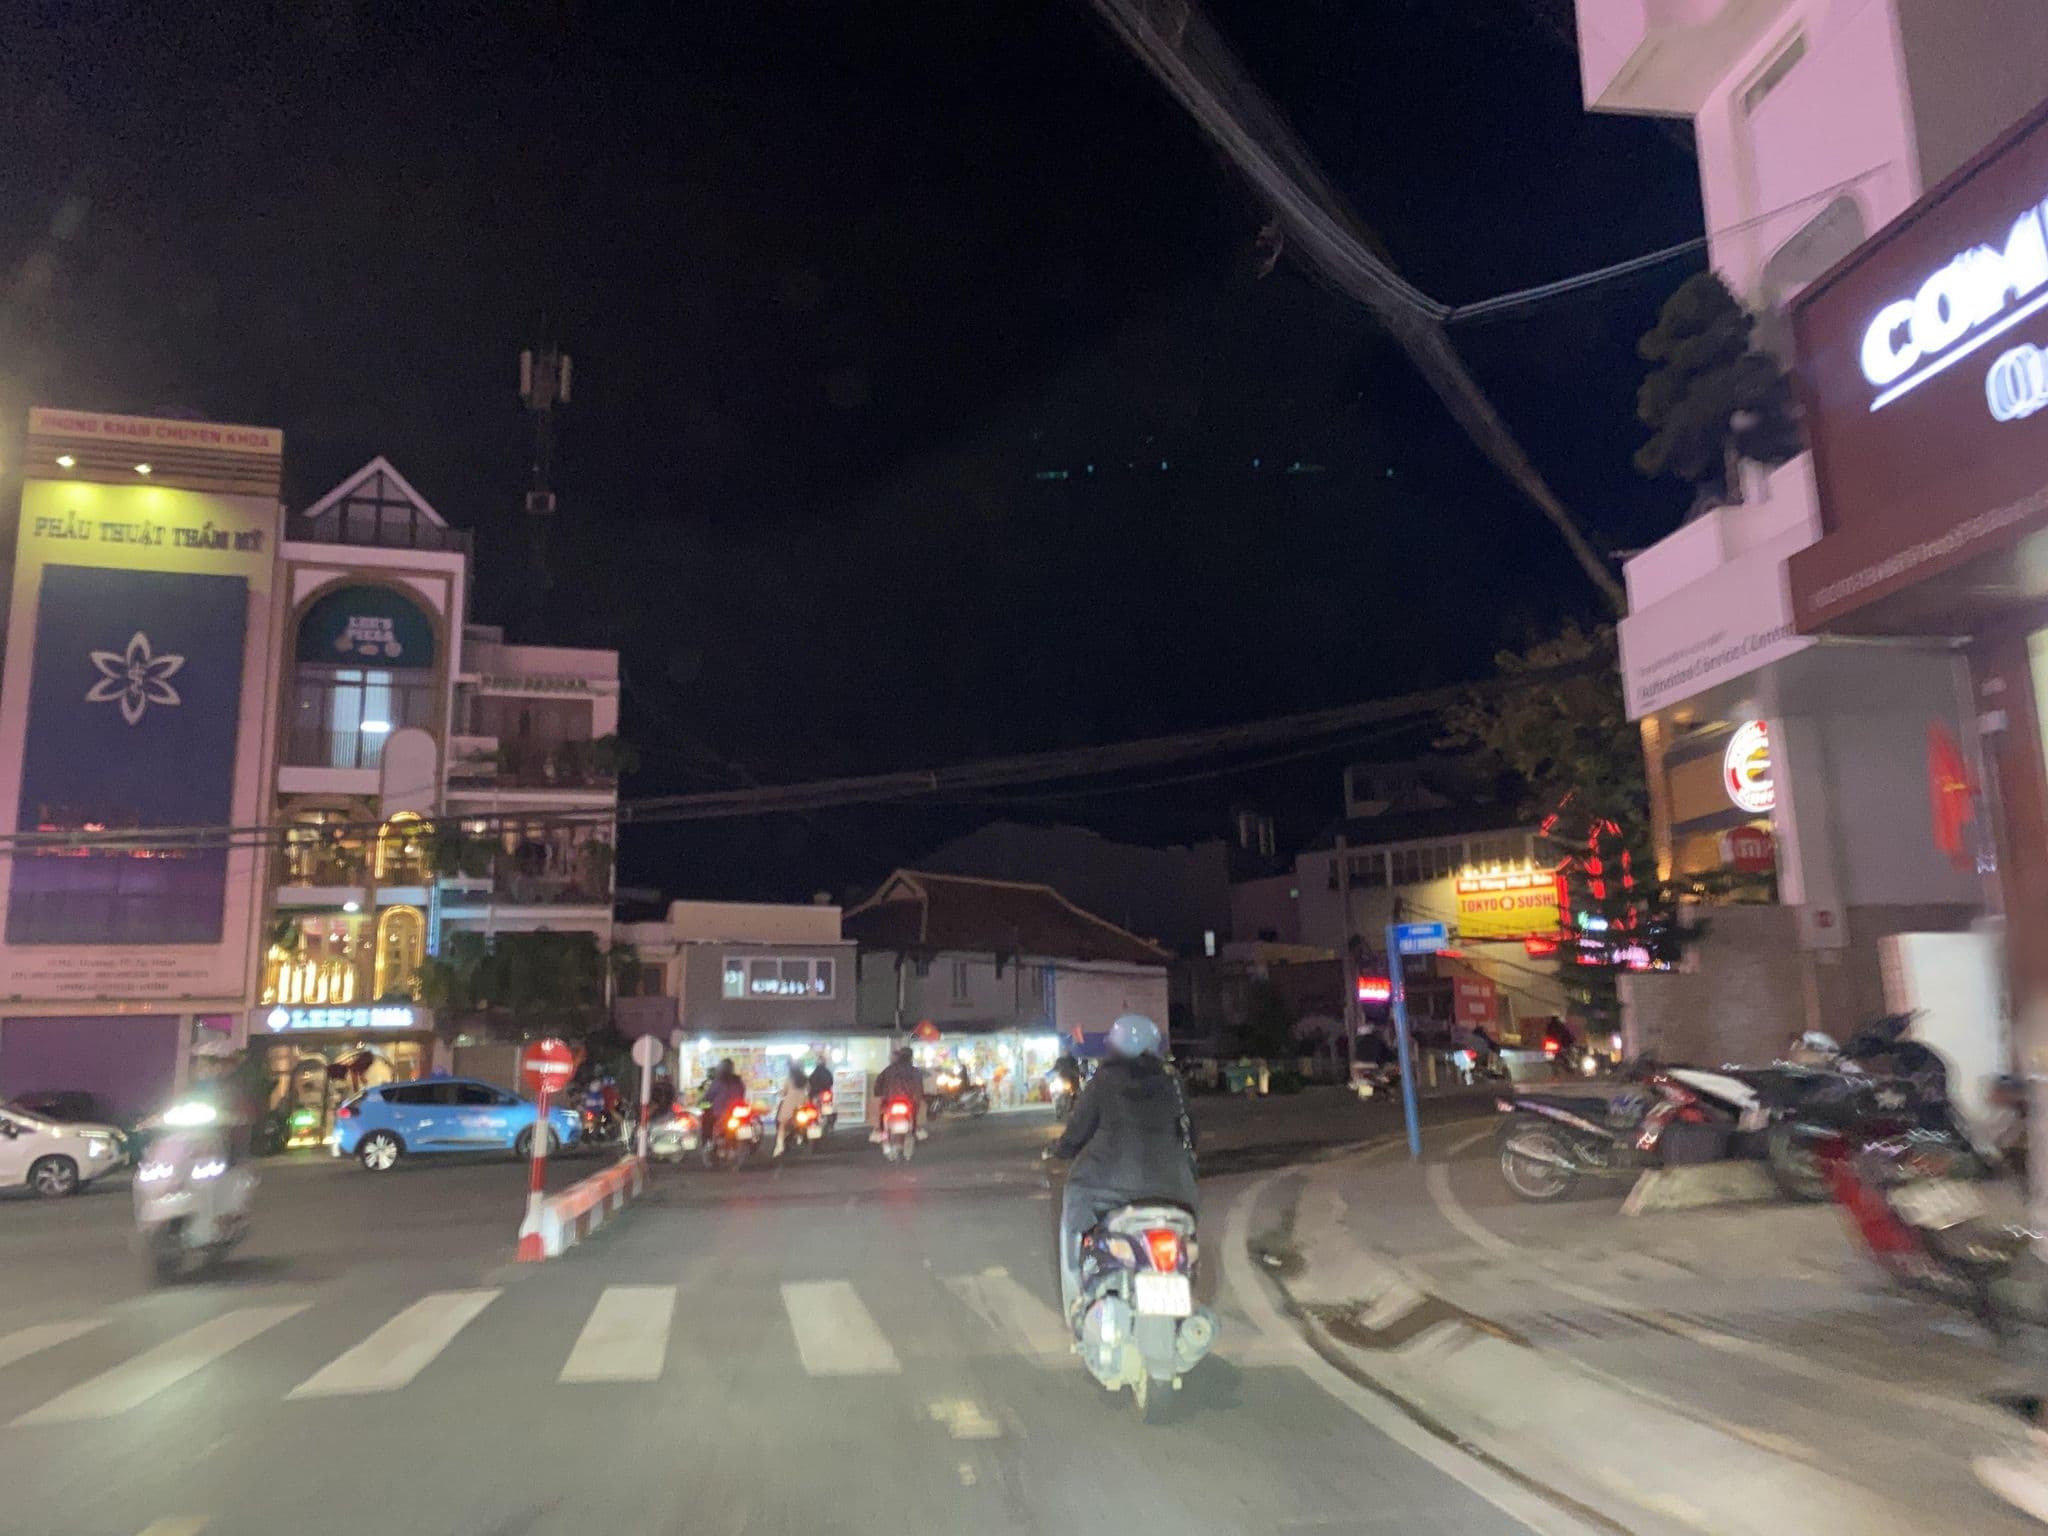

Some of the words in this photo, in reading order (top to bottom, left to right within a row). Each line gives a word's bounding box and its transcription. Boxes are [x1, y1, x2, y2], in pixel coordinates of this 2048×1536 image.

[1861, 196, 2048, 385] COM
[1461, 898, 1498, 913] TOKYO
[1517, 893, 1556, 908] SUSHI
